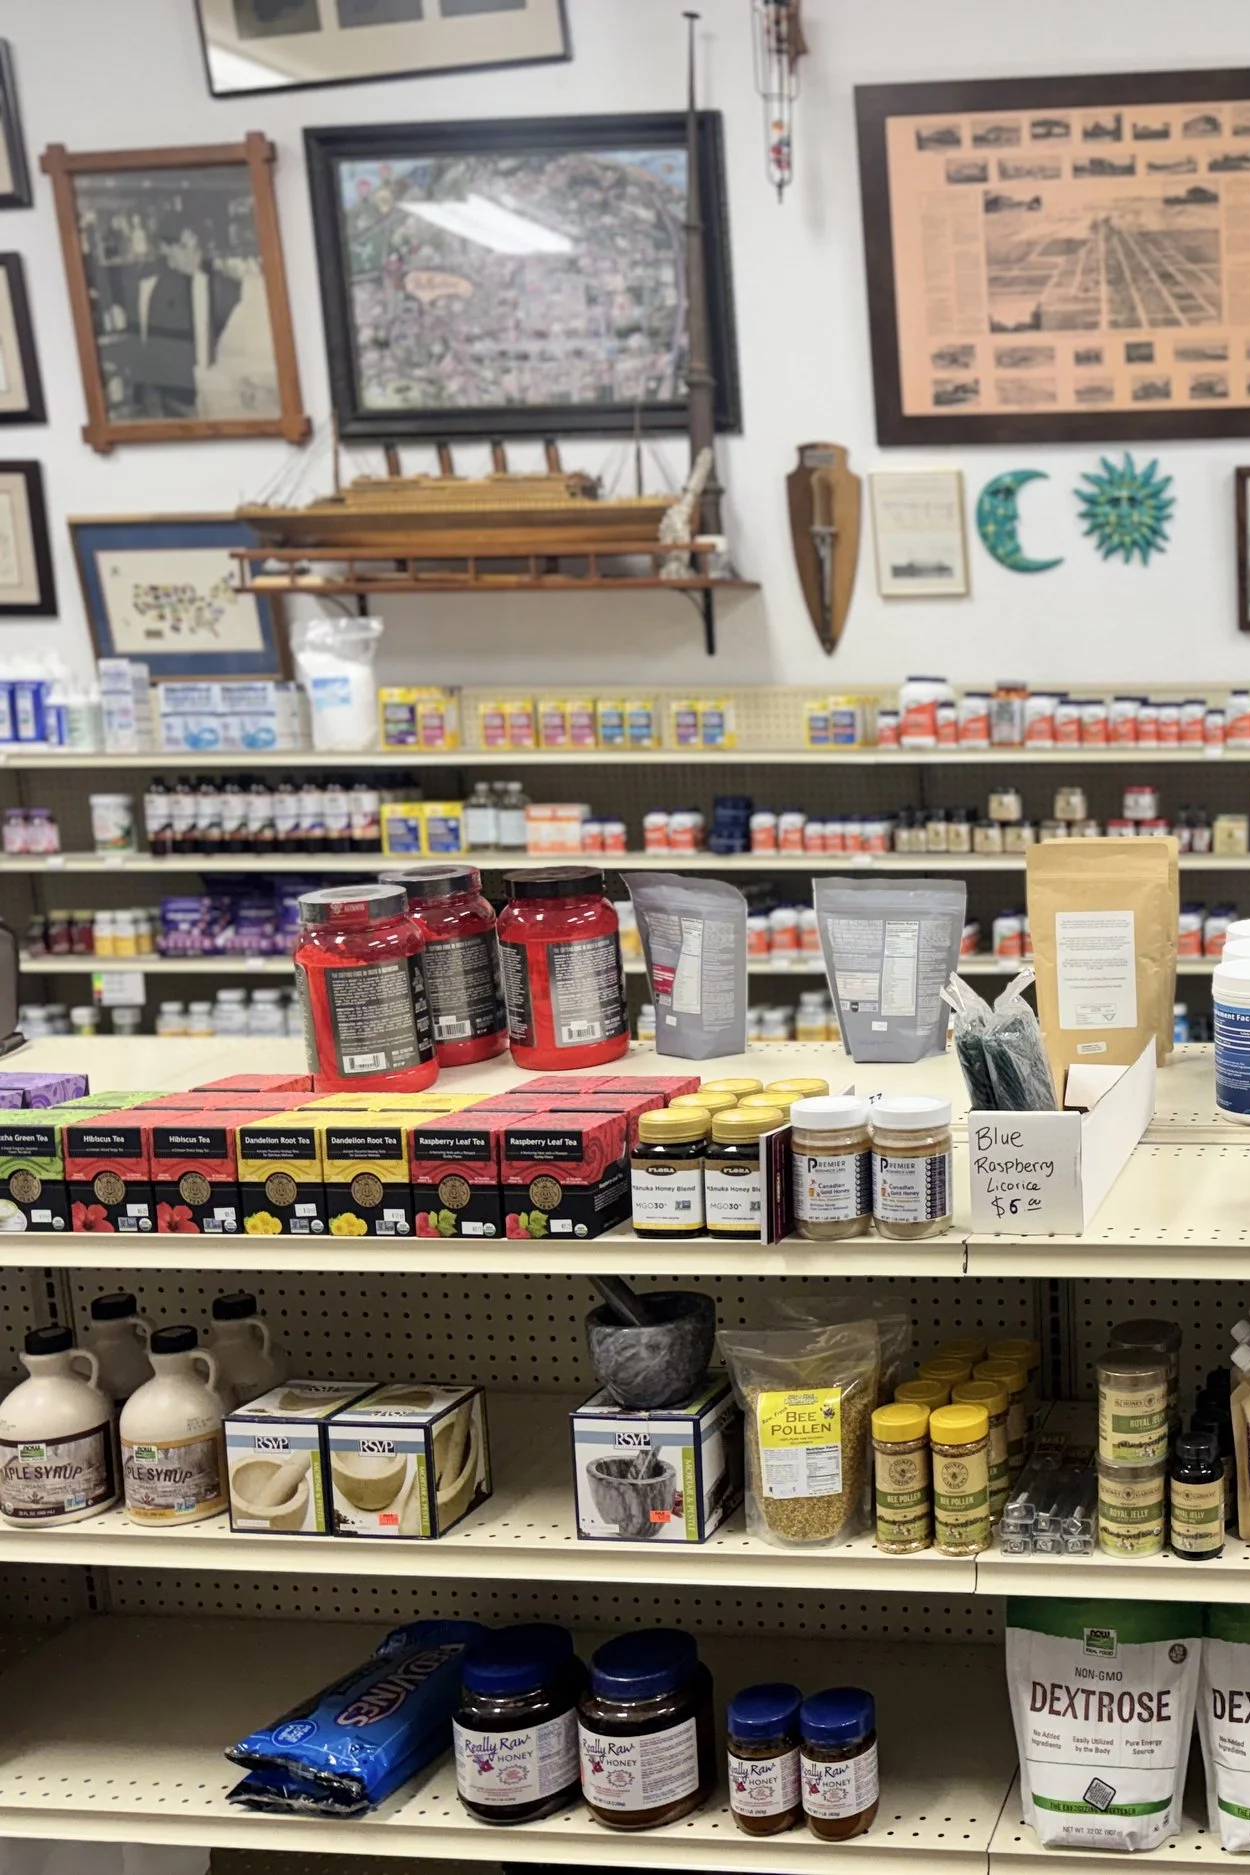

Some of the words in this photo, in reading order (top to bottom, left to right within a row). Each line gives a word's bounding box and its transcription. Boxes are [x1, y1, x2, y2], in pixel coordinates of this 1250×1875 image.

[15, 1134, 34, 1142] Green
[36, 1134, 48, 1142] Tea
[83, 1135, 109, 1143] Hibiscus
[197, 1136, 210, 1144] Tea
[420, 1138, 454, 1146] Raspberry
[456, 1138, 471, 1146] Leaf
[510, 1138, 546, 1146] Raspberry
[548, 1138, 563, 1146] Leaf
[975, 1126, 1024, 1151] Blue
[808, 1158, 845, 1173] PREMIER
[881, 1158, 915, 1173] PREMIER
[974, 1156, 1054, 1177] Raspberry
[987, 1177, 1041, 1193] Licorice
[786, 1412, 816, 1422] BEE
[1130, 1419, 1151, 1428] ROYAL
[771, 1423, 831, 1435] POLLEN
[254, 1436, 289, 1450] RSVP
[359, 1439, 395, 1454] RSVP
[614, 1432, 650, 1447] RSVP
[34, 1463, 82, 1480] SYRUP
[147, 1467, 193, 1484] SYRUP
[1109, 1509, 1129, 1518] ROYAL
[1130, 1509, 1149, 1518] JELLY
[1075, 1667, 1123, 1682] NON-GMO
[1030, 1680, 1172, 1724] DEXTROSE
[465, 1736, 498, 1761] Really
[499, 1735, 531, 1750] Raw
[1072, 1736, 1090, 1746] Easily
[1091, 1738, 1114, 1746] Utilized
[608, 1742, 635, 1755] Raw
[498, 1751, 533, 1762] HONEY
[750, 1762, 776, 1776] Raw
[824, 1764, 850, 1778] Raw
[749, 1777, 778, 1786] HONEY
[822, 1779, 851, 1788] HONEY
